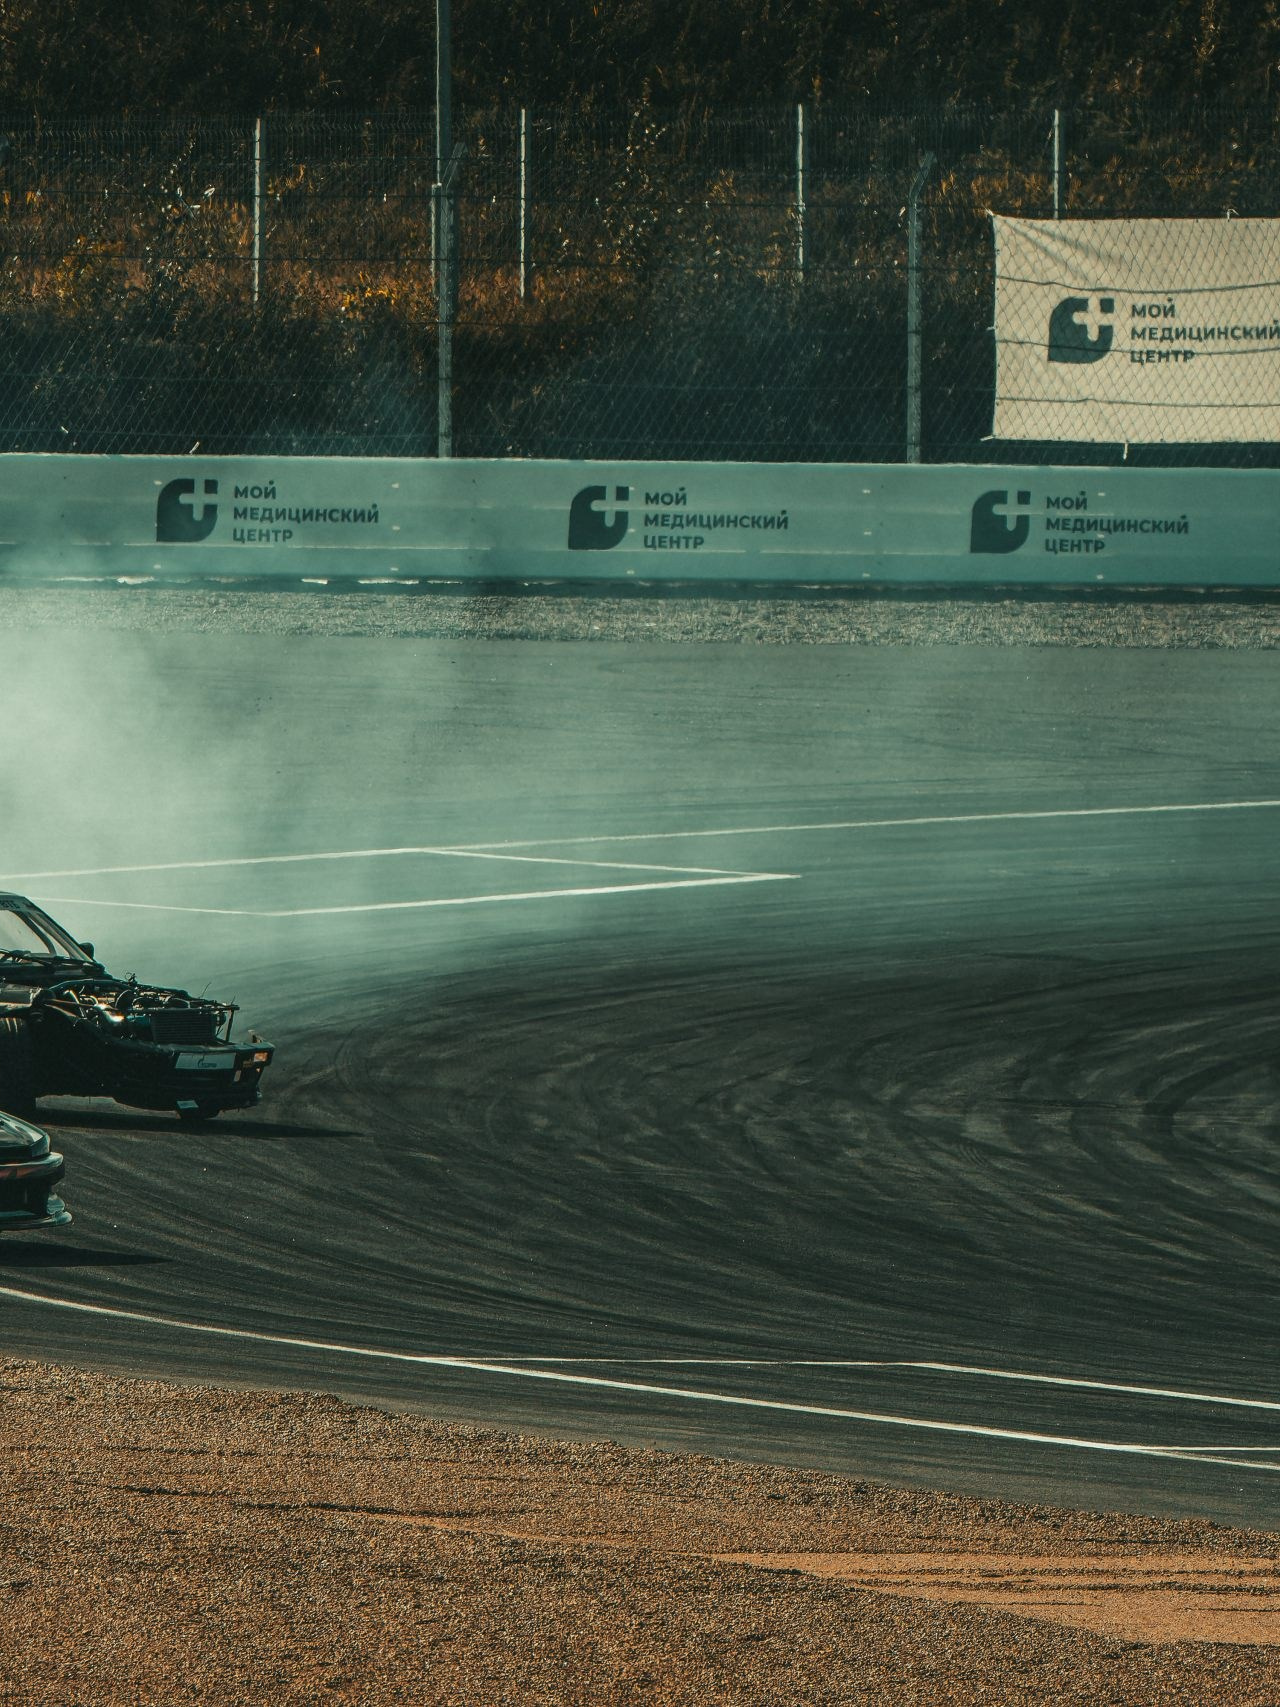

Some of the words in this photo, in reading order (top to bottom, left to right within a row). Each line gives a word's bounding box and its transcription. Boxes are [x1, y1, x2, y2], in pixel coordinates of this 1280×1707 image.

[1131, 296, 1176, 318] МОЙ
[1130, 319, 1280, 342] МЕДИЦИНСКИЙ
[1130, 349, 1196, 365] ЦЕНТР
[233, 480, 277, 499] МОЙ
[644, 487, 687, 505] МОЙ
[1046, 491, 1088, 510] МОЙ
[233, 504, 380, 524] МЕДИЦИНСКИЙ
[643, 510, 790, 530] МЕДИЦИНСКИЙ
[1045, 515, 1190, 534] МЕДИЦИНСКИЙ
[232, 528, 294, 543] ЦЕНТР
[643, 535, 705, 550] ЦЕНТР
[1044, 539, 1106, 554] ЦЕНТР
